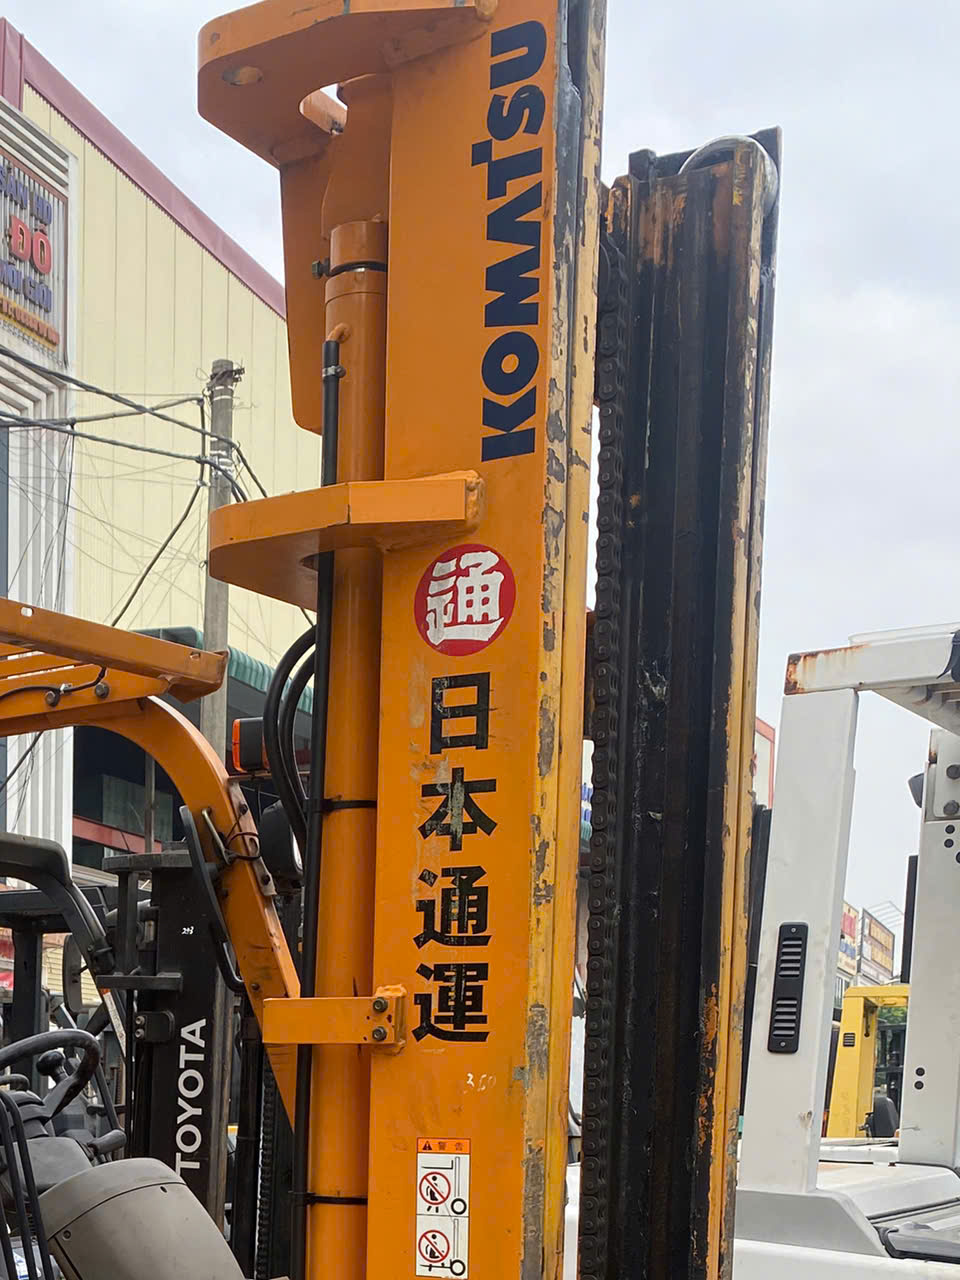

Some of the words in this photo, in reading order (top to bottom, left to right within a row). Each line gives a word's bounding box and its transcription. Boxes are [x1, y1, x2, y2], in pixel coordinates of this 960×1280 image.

[471, 19, 549, 462] KOMATSU
[425, 549, 504, 646] 通
[412, 672, 497, 1043] 日本通運
[175, 1018, 207, 1177] TOYOTA
